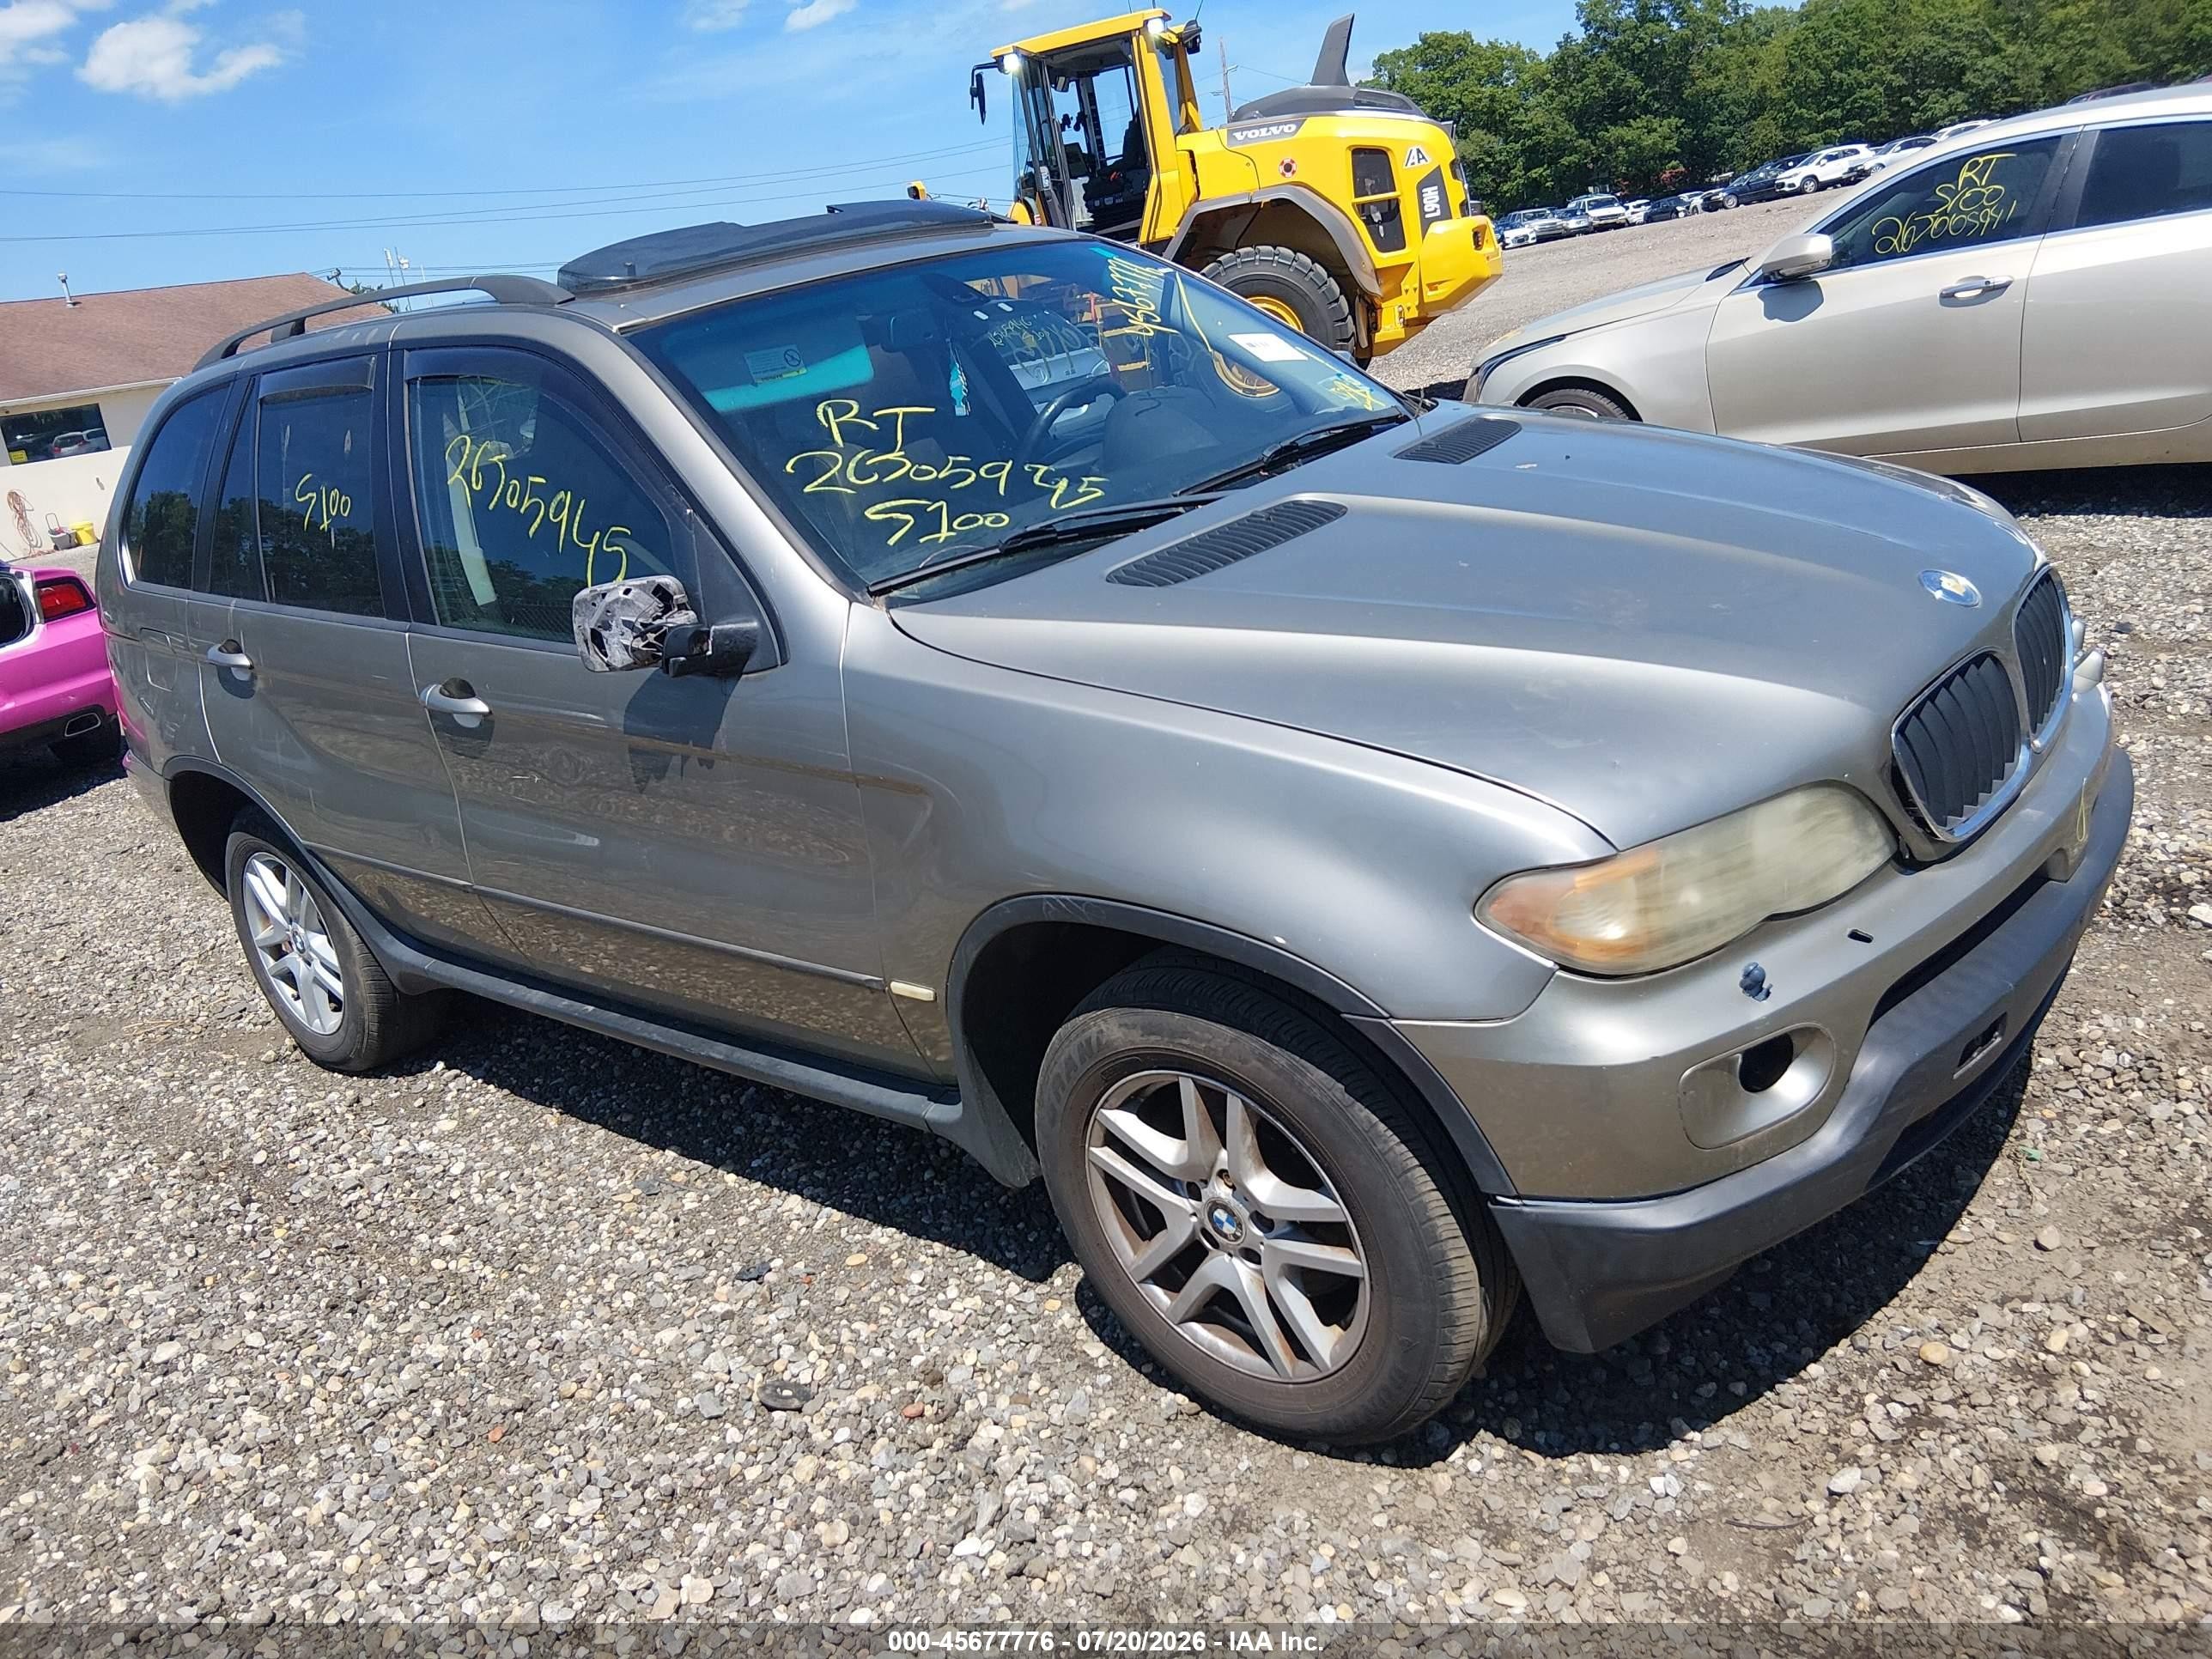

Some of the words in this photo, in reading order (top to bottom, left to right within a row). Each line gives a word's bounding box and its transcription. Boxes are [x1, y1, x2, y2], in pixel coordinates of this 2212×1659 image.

[1232, 124, 1297, 141] VOLVO
[1957, 153, 2017, 191] RT
[1421, 185, 1442, 218] L90H
